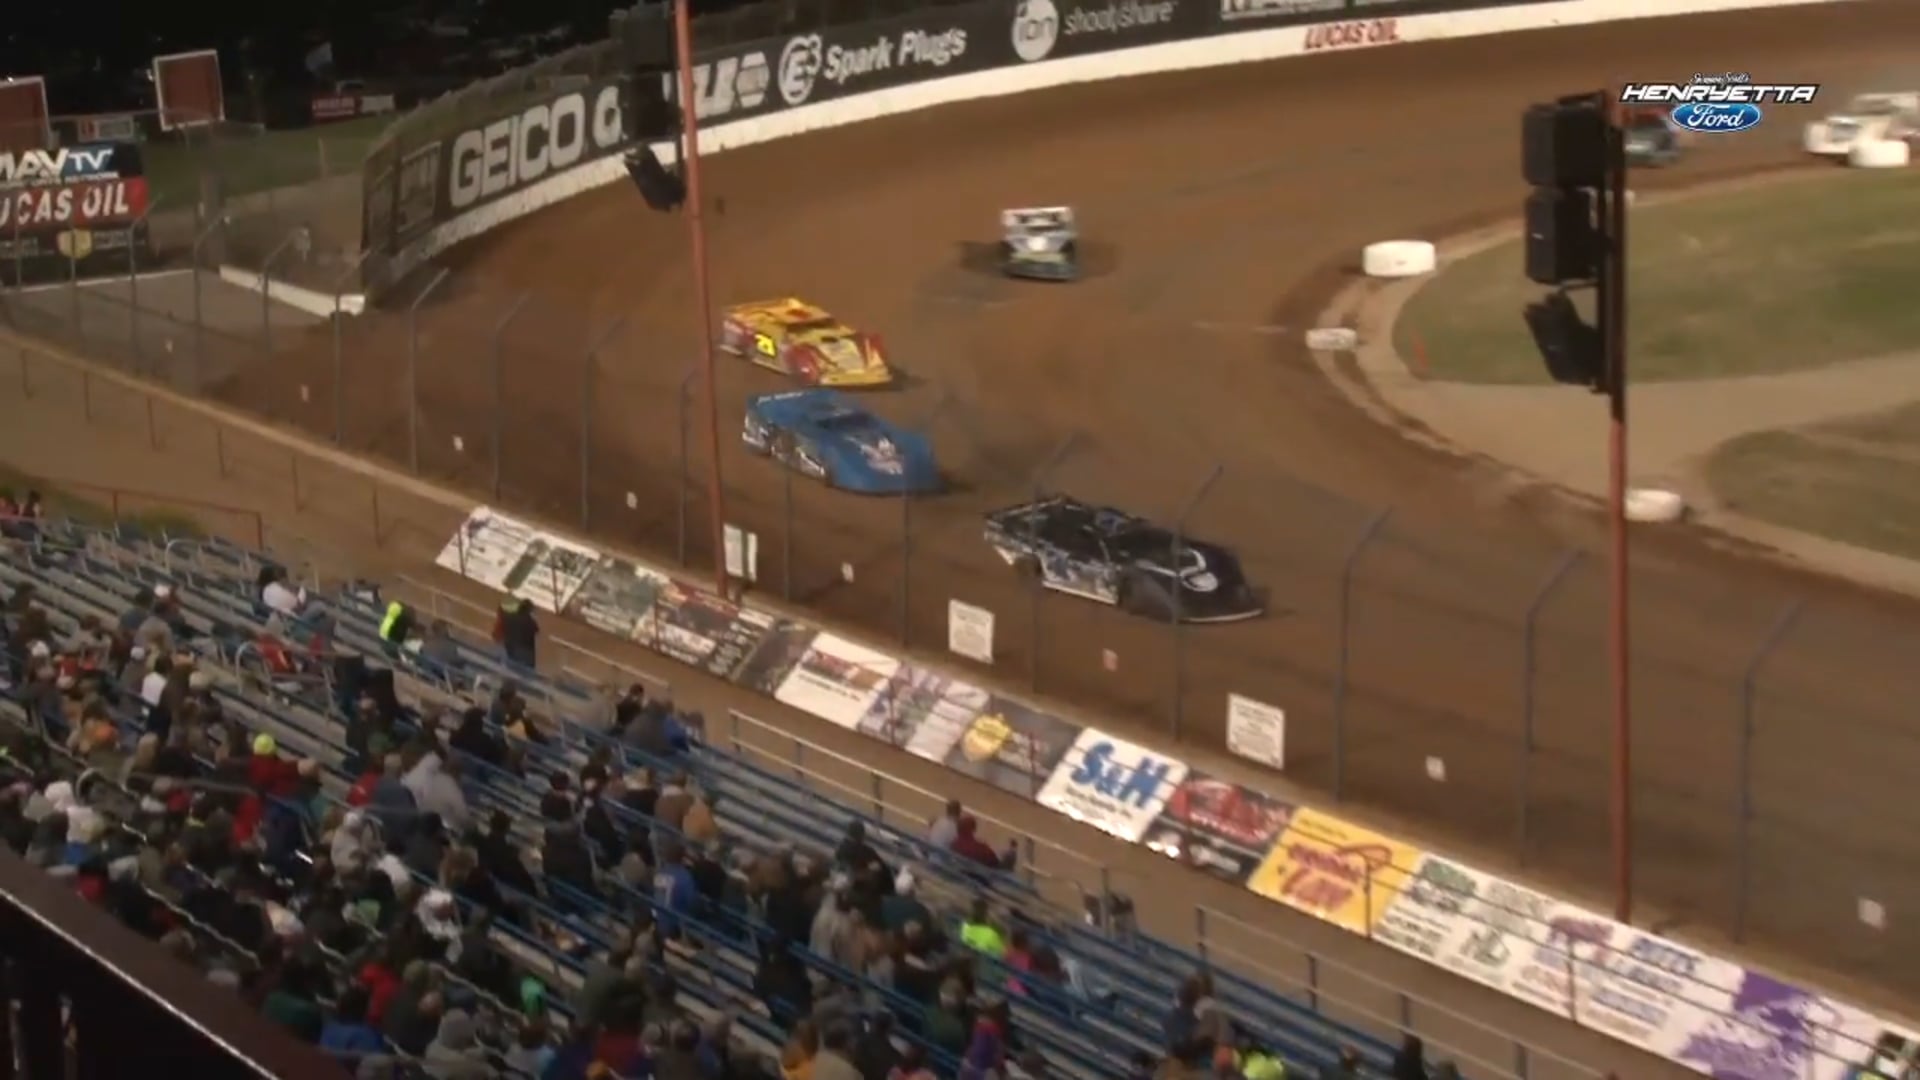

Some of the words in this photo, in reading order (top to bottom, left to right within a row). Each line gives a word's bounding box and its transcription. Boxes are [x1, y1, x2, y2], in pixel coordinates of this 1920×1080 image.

[823, 36, 894, 84] Spark
[899, 28, 967, 66] Plugs
[1304, 21, 1365, 50] LUCAS
[1367, 18, 1397, 43] OIL
[451, 94, 585, 206] GEICO
[82, 182, 129, 219] OIL
[1070, 741, 1172, 808] S&H
